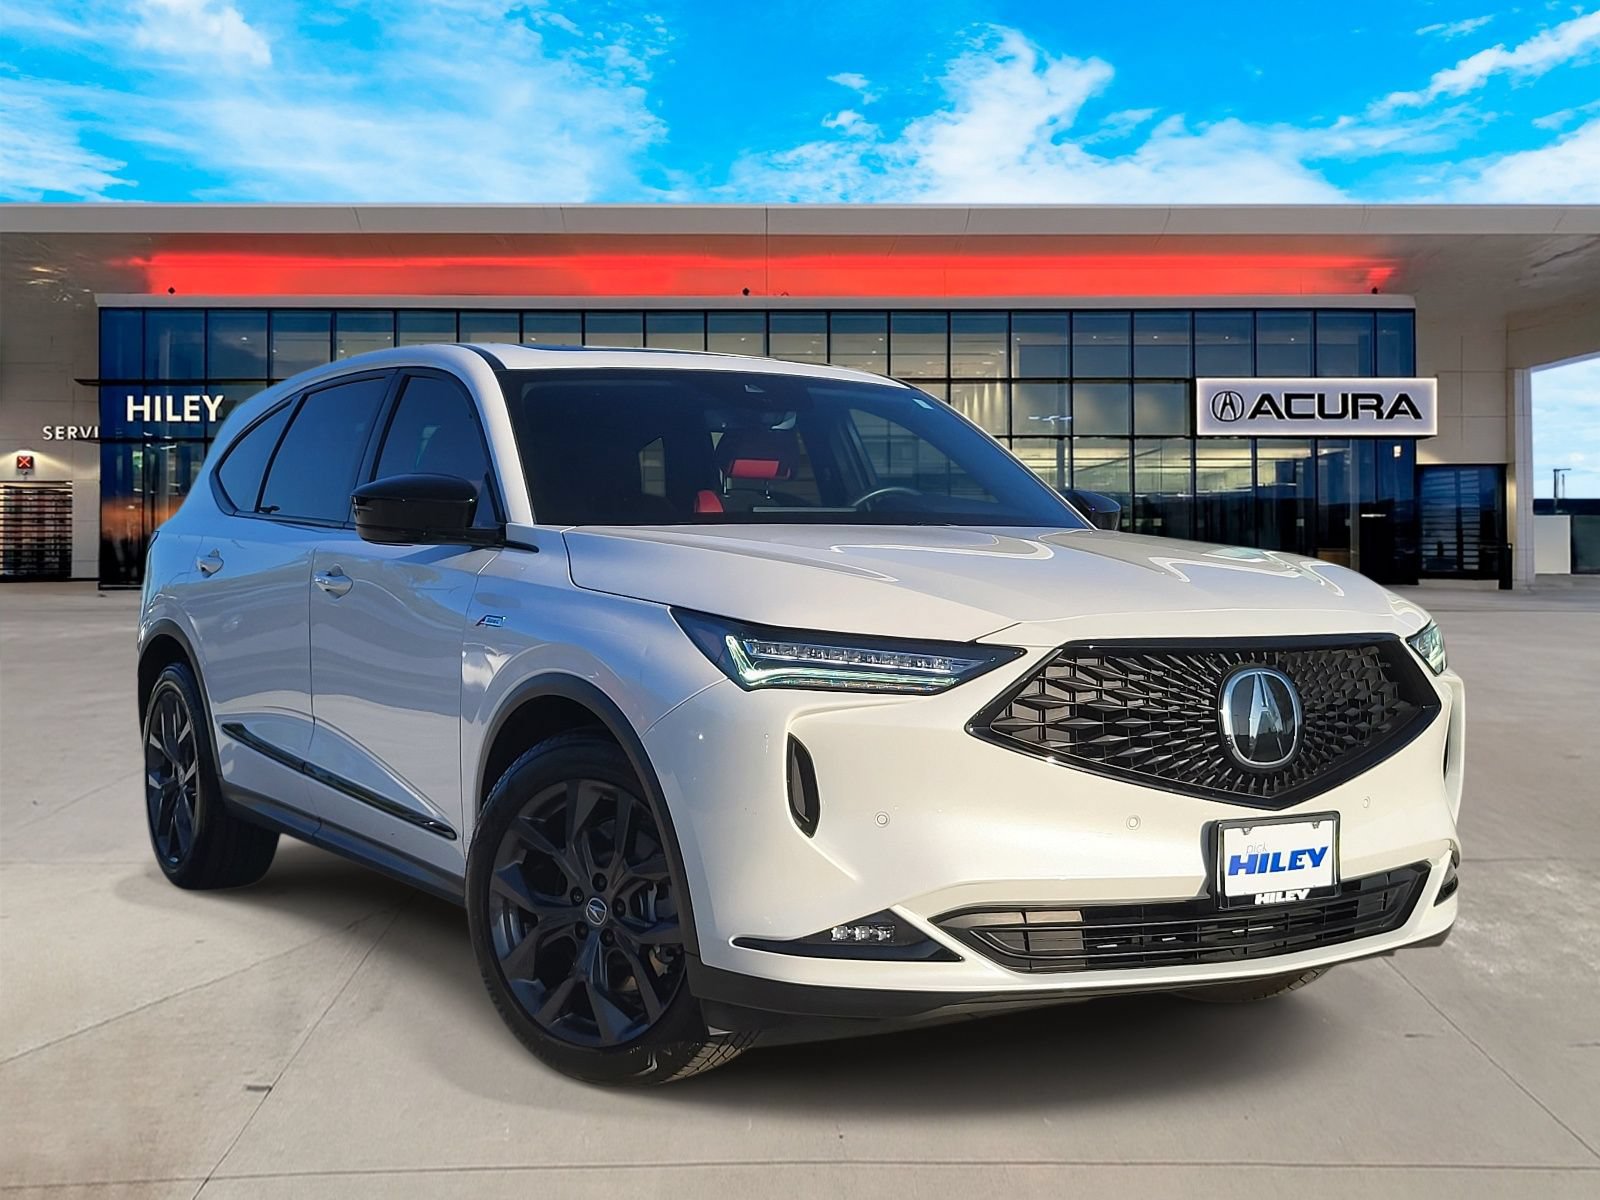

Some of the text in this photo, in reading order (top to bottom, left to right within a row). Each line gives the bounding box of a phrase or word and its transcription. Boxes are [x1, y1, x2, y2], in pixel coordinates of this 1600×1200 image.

[126, 395, 224, 422] HILEY
[1248, 392, 1422, 420] ACURA
[1227, 845, 1329, 876] HILEY
[1254, 888, 1311, 905] HILEY
